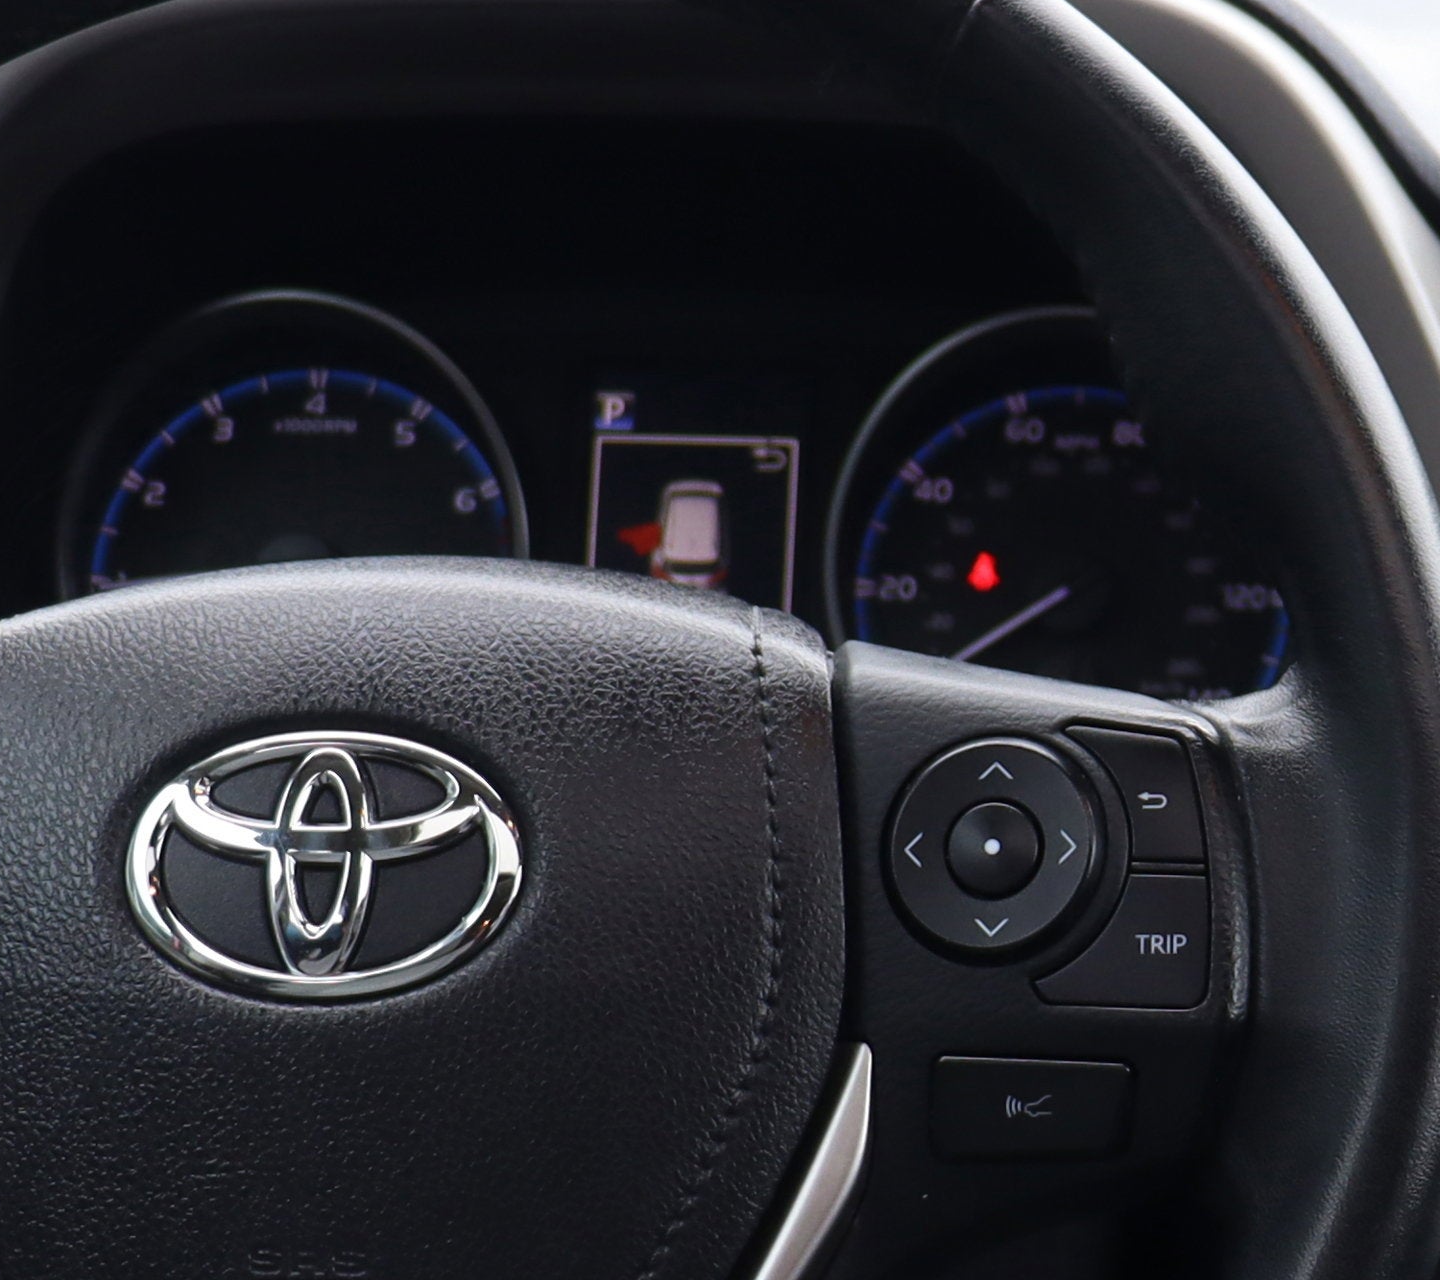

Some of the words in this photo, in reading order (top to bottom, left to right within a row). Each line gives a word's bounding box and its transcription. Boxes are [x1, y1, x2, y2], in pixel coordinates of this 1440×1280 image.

[304, 391, 329, 416] 4
[602, 395, 626, 426] P
[211, 420, 235, 445] 3
[394, 421, 417, 448] 5
[1004, 417, 1046, 444] 60
[142, 480, 169, 508] 2
[453, 487, 478, 514] 6
[912, 476, 955, 504] 40
[878, 574, 919, 602] 20
[1135, 934, 1188, 955] TRIP
